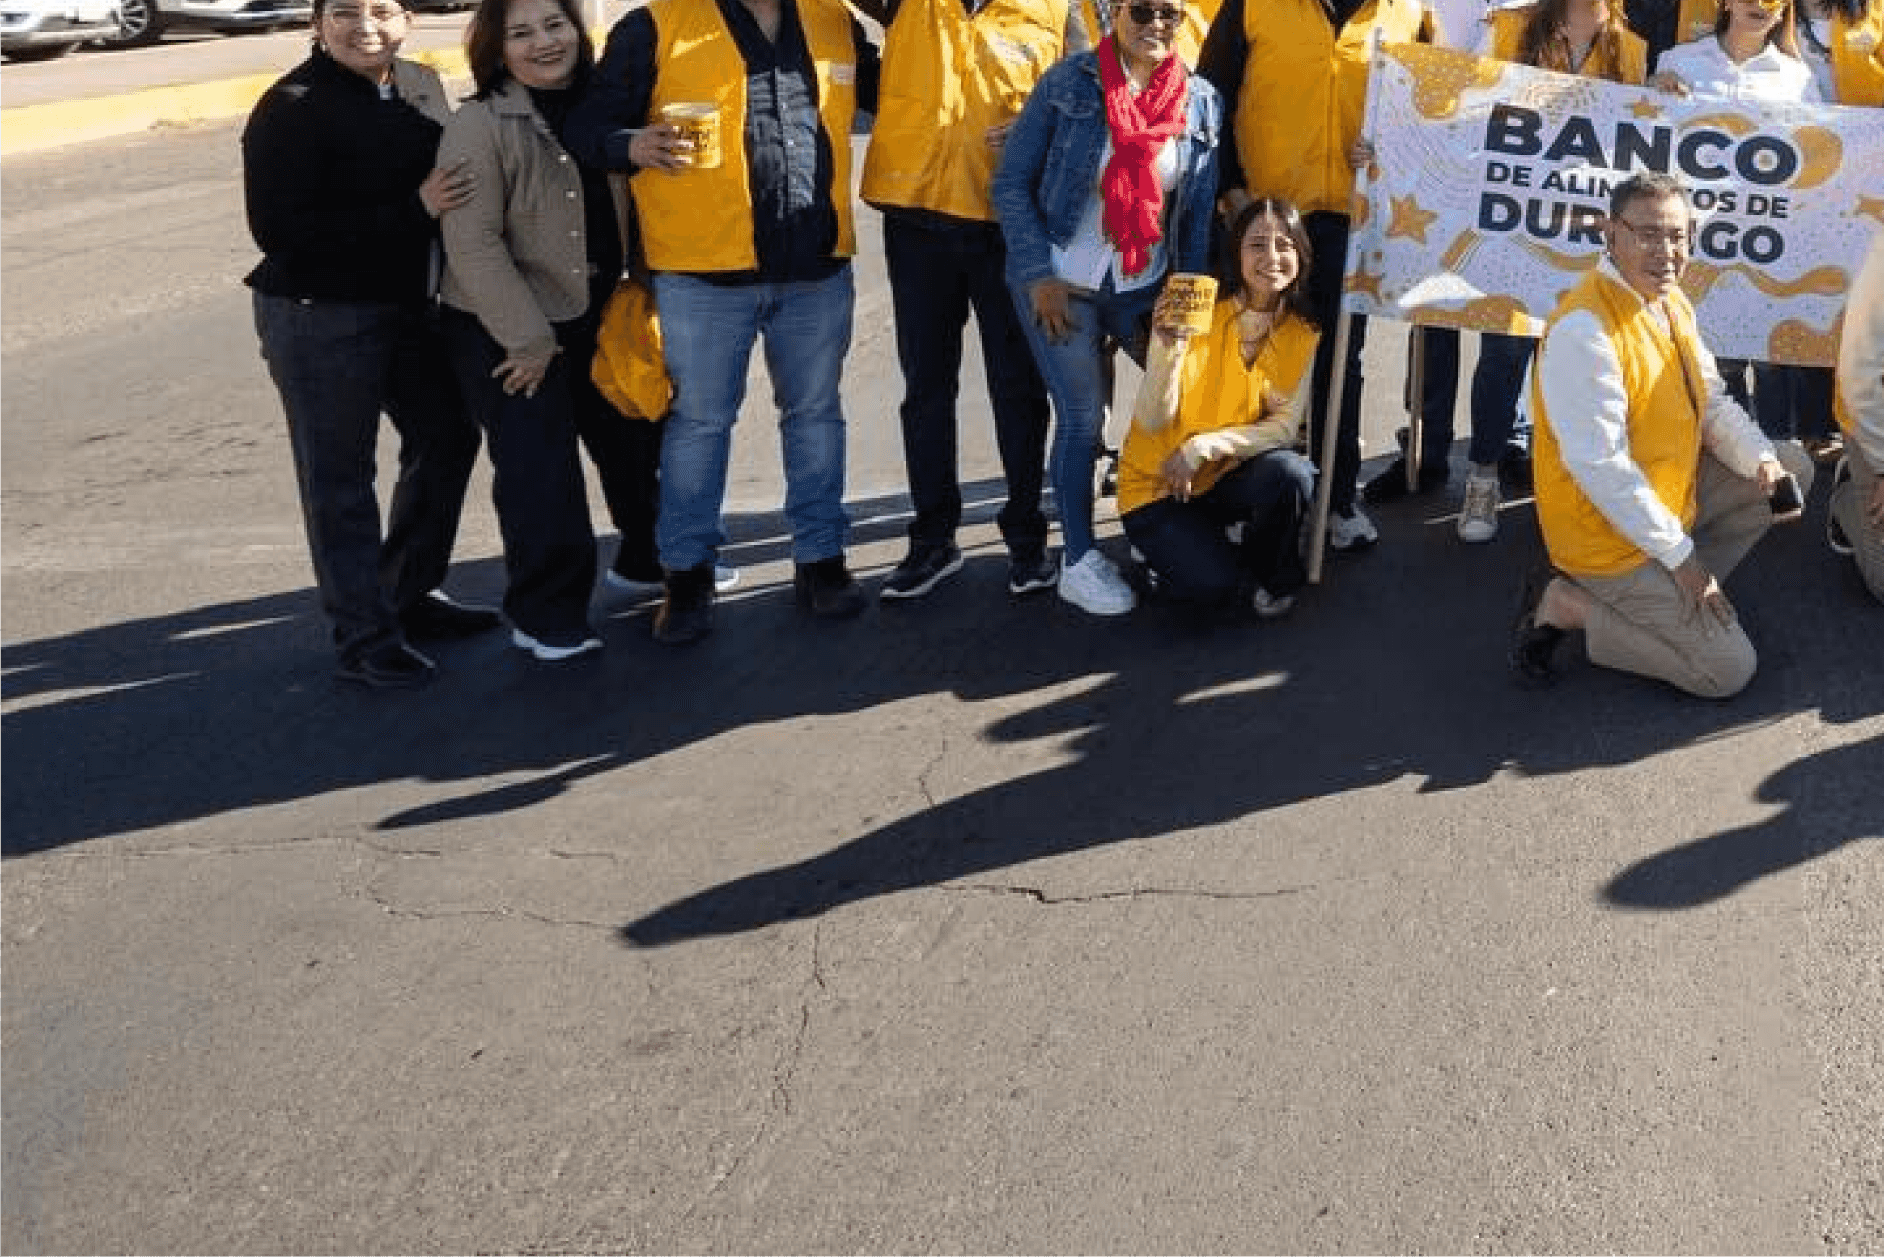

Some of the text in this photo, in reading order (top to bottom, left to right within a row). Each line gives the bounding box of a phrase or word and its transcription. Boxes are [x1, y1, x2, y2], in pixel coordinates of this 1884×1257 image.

[1484, 102, 1798, 185] BANCO
[1486, 159, 1532, 187] DE
[1746, 193, 1789, 219] DE
[1478, 191, 1785, 264] DURGO
